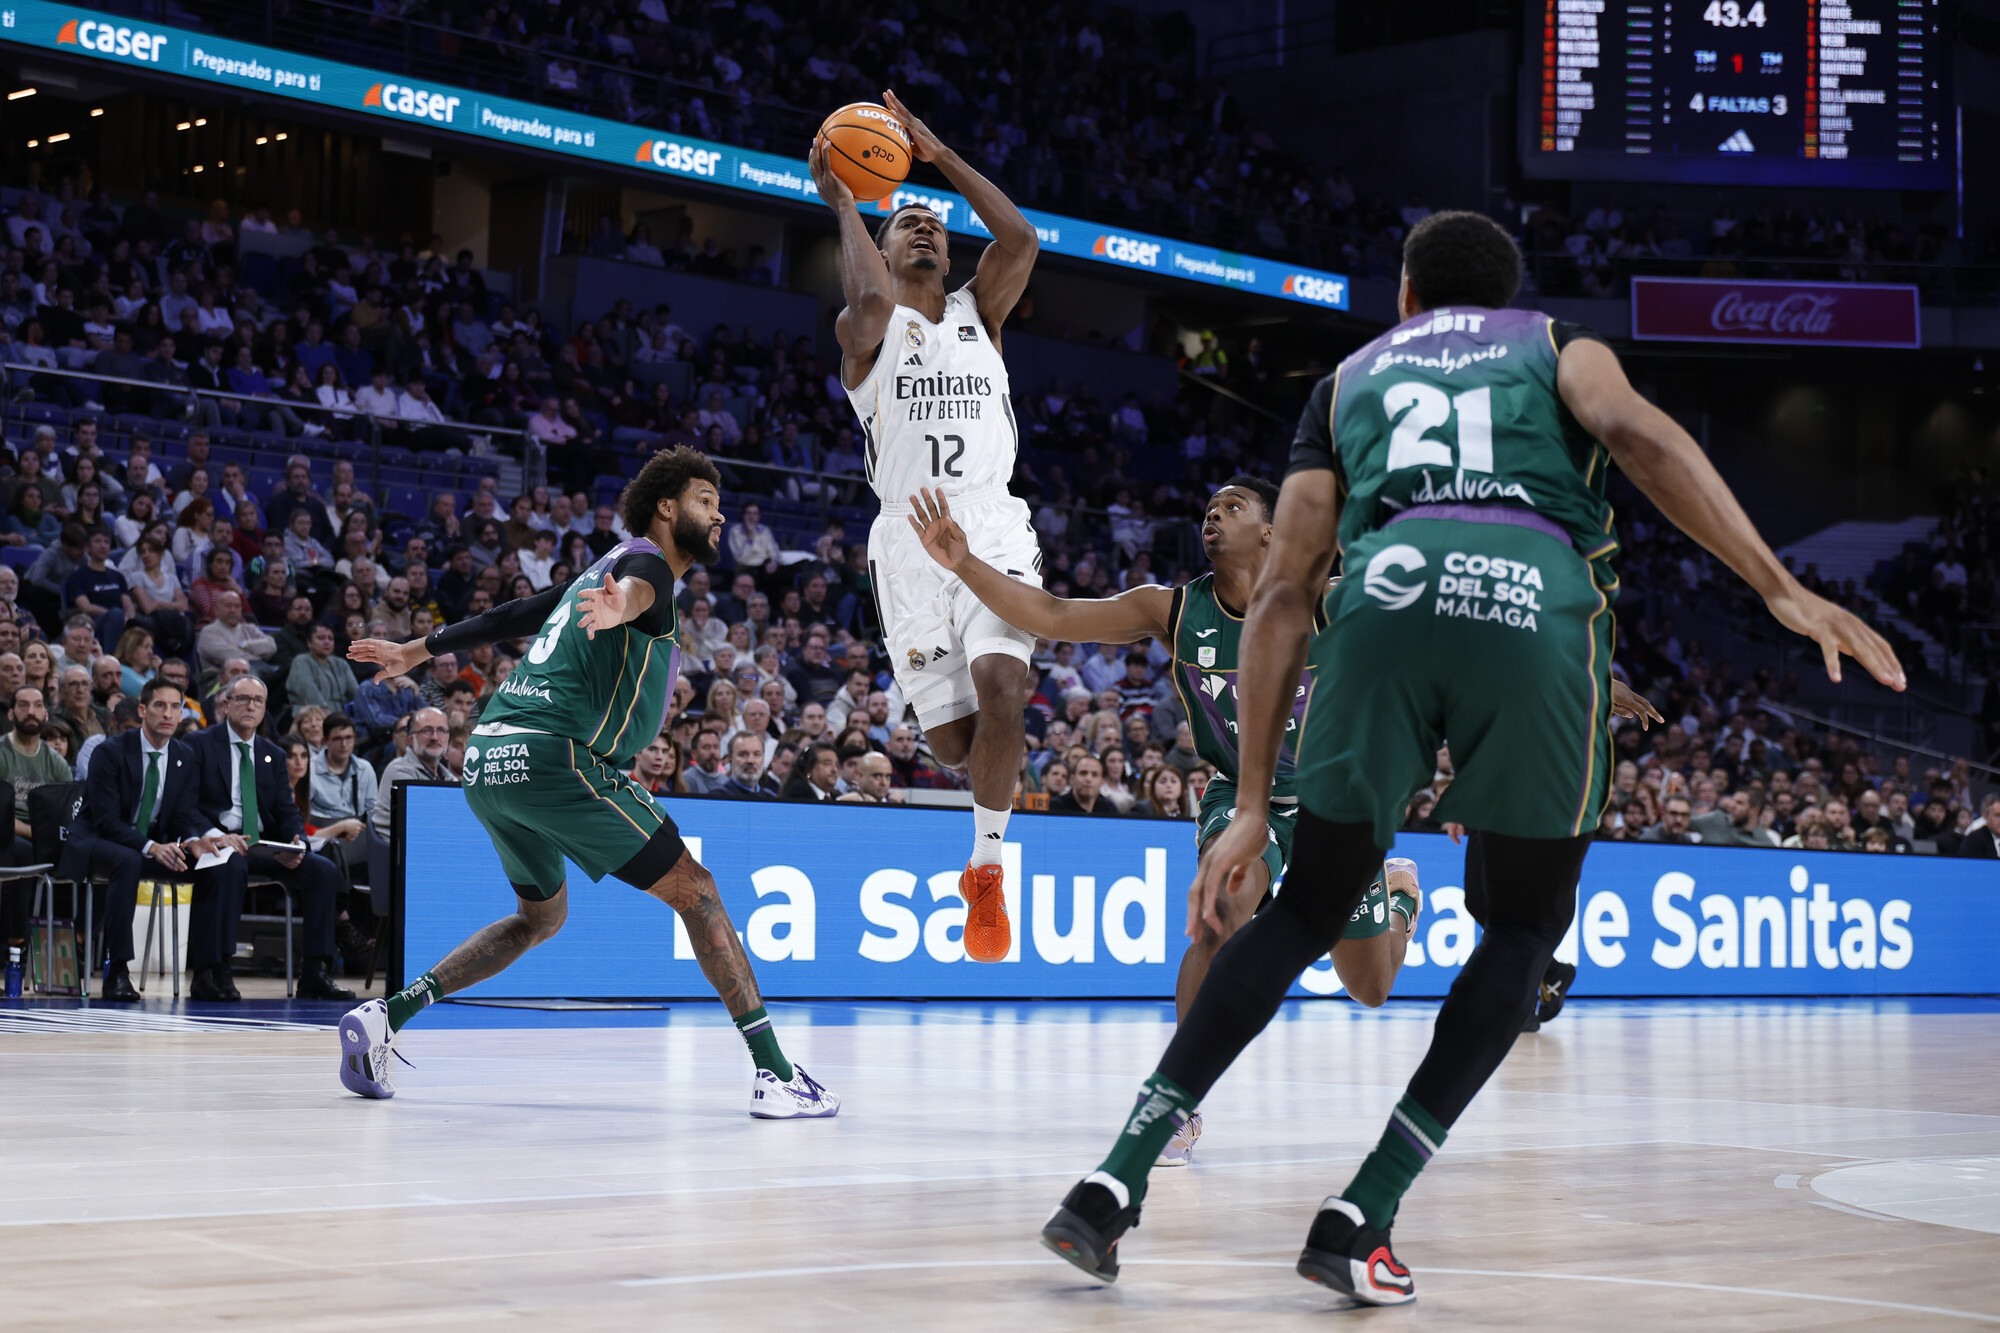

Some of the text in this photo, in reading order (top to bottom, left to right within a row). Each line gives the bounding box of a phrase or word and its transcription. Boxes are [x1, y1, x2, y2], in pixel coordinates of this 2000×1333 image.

[2, 10, 14, 27] ti
[1703, 0, 1767, 27] 43.4
[78, 20, 167, 62] caser
[192, 48, 321, 91] Preparados para ti
[1731, 53, 1743, 74] 1
[382, 83, 460, 123] caser
[1689, 92, 1788, 116] 4 FALTAS 3
[482, 107, 595, 147] Preparados para ti
[652, 140, 721, 176] caser
[872, 145, 895, 162] acb
[740, 162, 819, 196] Preparados pa
[1105, 235, 1161, 267] caser
[1175, 253, 1225, 278] Preparados
[1293, 274, 1344, 304] caser
[896, 371, 992, 400] Emirates
[909, 400, 981, 421] FLY BETTER
[1383, 381, 1493, 474] 21
[925, 434, 965, 478] 12
[1444, 551, 1544, 591] COSTA
[1438, 574, 1541, 612] DEL SOL
[1434, 597, 1538, 633] MÁLAGA
[499, 675, 553, 703] ndalucía
[484, 759, 530, 774] DEL SOL
[485, 743, 530, 760] COSTA
[484, 772, 531, 787] MÁLAGA
[858, 841, 1167, 965] salud
[1651, 865, 1914, 970] Sanitas
